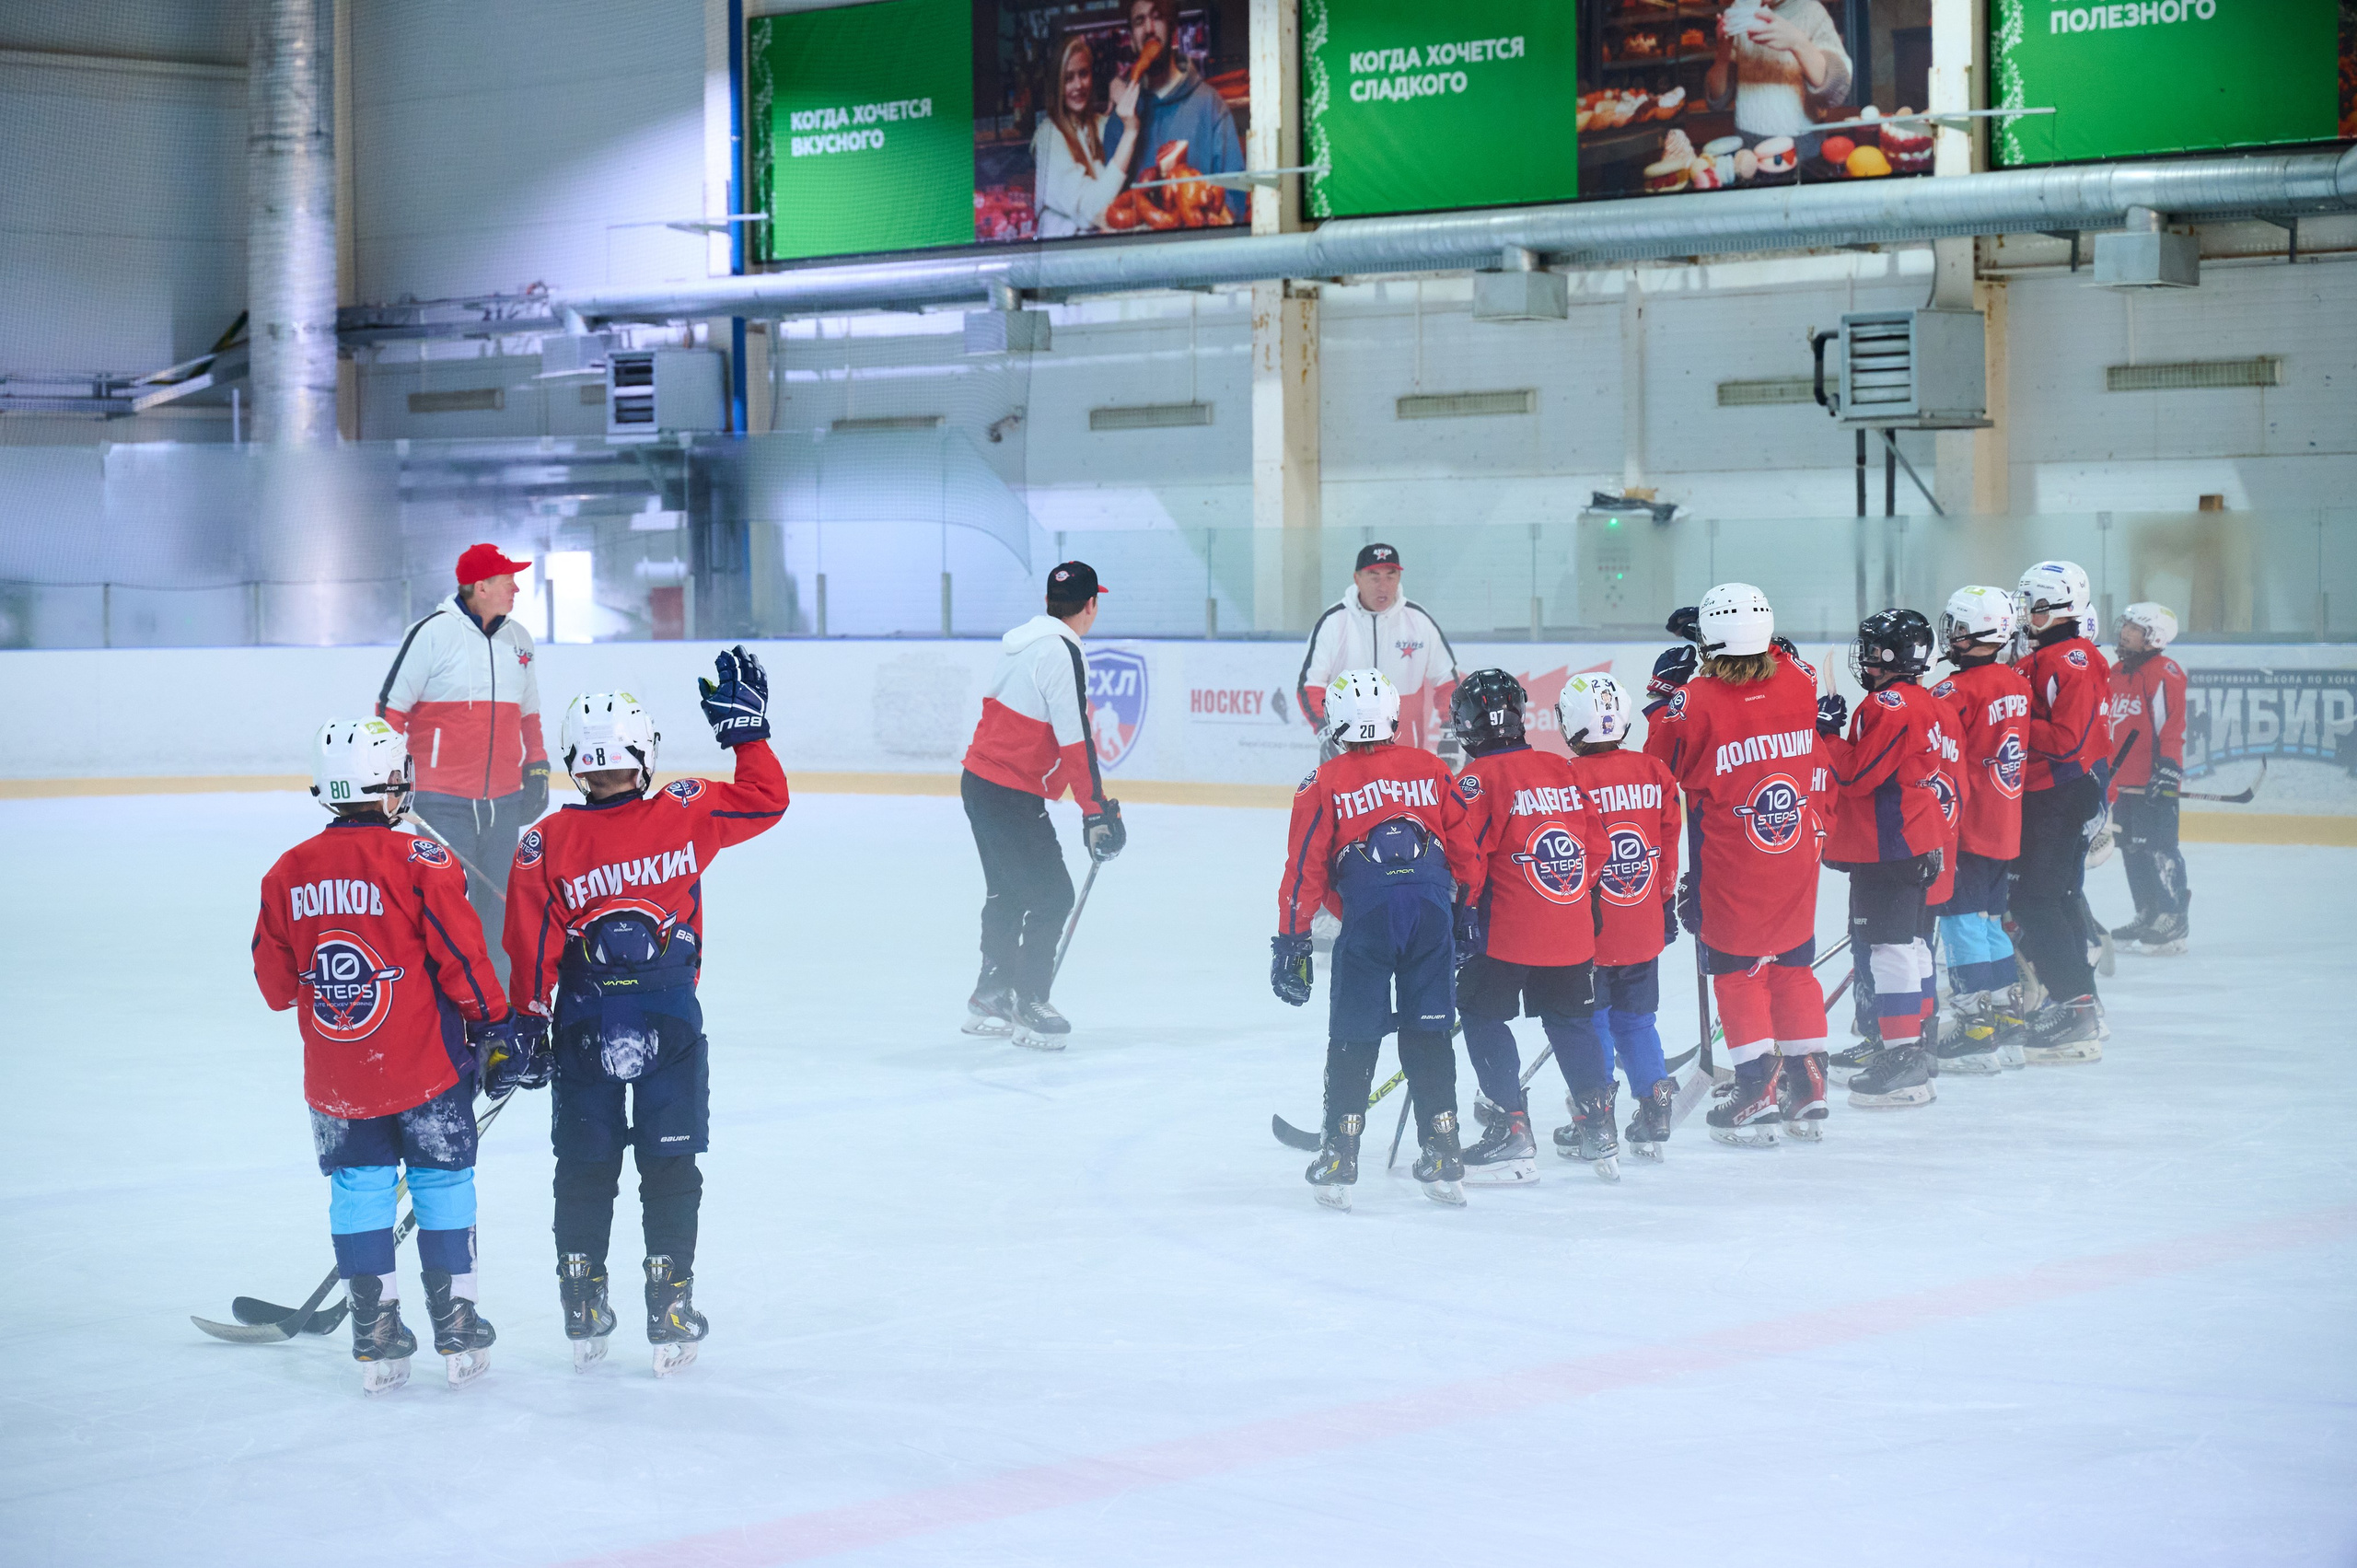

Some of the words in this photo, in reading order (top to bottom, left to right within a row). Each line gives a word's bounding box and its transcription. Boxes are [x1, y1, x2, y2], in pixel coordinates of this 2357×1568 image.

[2050, 0, 2216, 34] ПОЛЕЗНОГО
[1350, 47, 1422, 74] КОГДА
[1425, 36, 1525, 67] ХОЧЕТСЯ
[1350, 71, 1468, 102] СЛАДКОГО
[790, 107, 850, 131] КОГДА
[853, 98, 932, 124] ХОЧЕТСЯ
[791, 128, 885, 157] ВКУСНОГО
[2190, 673, 2259, 684] СПОРТИВНАЯ
[2264, 674, 2302, 685] ШКОЛА
[2307, 675, 2322, 684] ПО
[2328, 675, 2357, 685] ХОКК
[1190, 689, 1264, 715] HOCKEY
[713, 716, 762, 735] BAUE
[1489, 709, 1504, 726] 97
[1360, 725, 1375, 738] 20
[596, 748, 606, 766] 8
[1715, 729, 1813, 776] ДОЛГУШИН
[330, 780, 351, 799] 80
[1462, 777, 1477, 786] 10
[1333, 778, 1439, 819] СТЕПЧЕНК
[1766, 788, 1792, 811] 10
[1757, 810, 1796, 826] STEPS
[526, 832, 540, 847] 10
[1543, 836, 1574, 858] 10
[1611, 839, 1641, 861] 10
[562, 840, 698, 910] ВЕЛИЧКИН
[1539, 859, 1583, 874] STEPS
[1602, 860, 1649, 877] STEPS
[290, 879, 384, 922] ВОЛКОВ
[675, 929, 696, 946] BAU
[318, 953, 360, 981] 10
[314, 983, 374, 999] STEPS
[1806, 1060, 1820, 1080] CCM
[1732, 1095, 1771, 1125] CCM
[660, 1134, 691, 1144] BAUER
